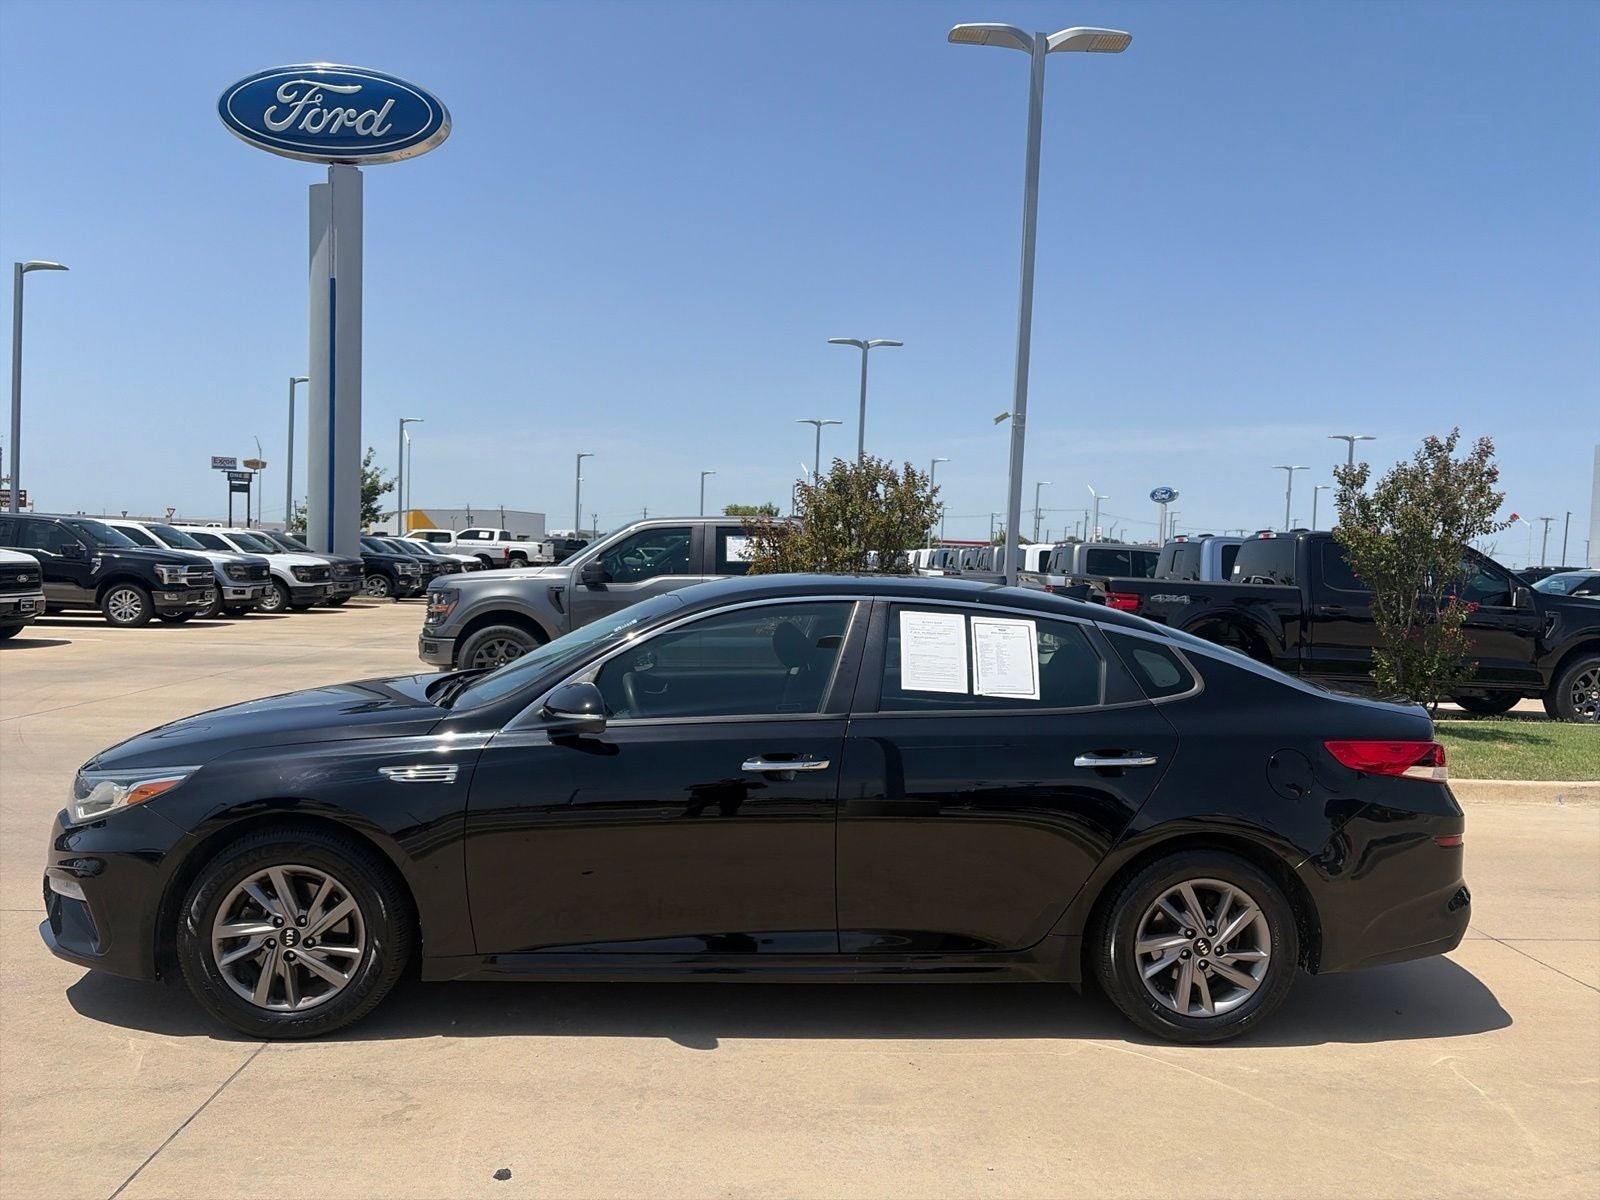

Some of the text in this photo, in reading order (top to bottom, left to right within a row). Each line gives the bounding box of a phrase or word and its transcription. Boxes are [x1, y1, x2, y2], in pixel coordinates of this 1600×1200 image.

[264, 79, 395, 137] Ford
[286, 929, 294, 946] KIA
[1197, 939, 1209, 955] KIA
